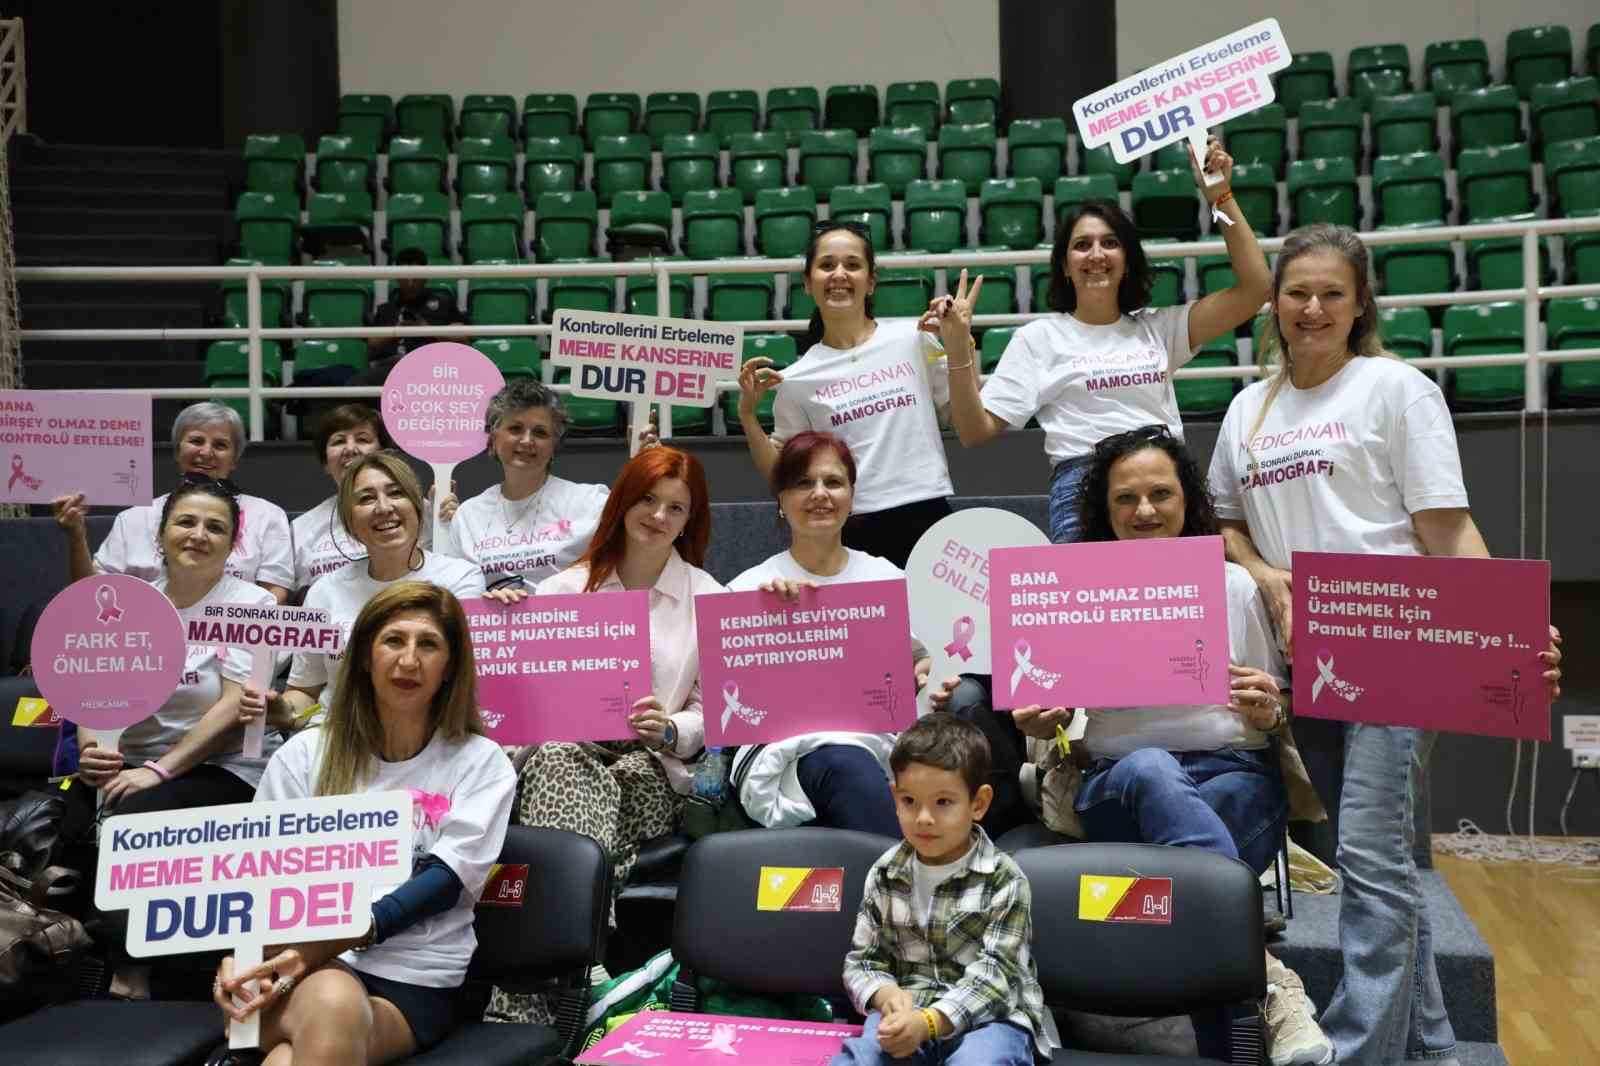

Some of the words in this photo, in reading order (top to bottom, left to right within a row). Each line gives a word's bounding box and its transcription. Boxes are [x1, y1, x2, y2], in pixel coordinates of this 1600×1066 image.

[1081, 63, 1186, 118] Kontrollerini
[1189, 29, 1271, 71] Erteleme
[1087, 99, 1152, 137] MEME
[1120, 104, 1195, 153] DUR
[1200, 77, 1262, 119] DE!
[559, 317, 657, 339] Kontrollerini
[661, 326, 735, 346] Erteleme
[559, 339, 616, 359] MEME
[432, 363, 458, 379] BİR
[581, 364, 646, 394] DUR
[655, 370, 706, 399] DE!
[47, 418, 97, 430] OLMAZ
[100, 420, 141, 431] DEME!
[73, 435, 145, 447] ERTELEME!
[1010, 571, 1059, 586] BANA
[1307, 575, 1410, 598] ÜzülMEMEk
[1416, 587, 1438, 599] ve
[1010, 588, 1070, 608] BİRŞEY
[1076, 588, 1139, 603] OLMAZ
[1144, 584, 1199, 600] DEME!
[282, 610, 327, 623] DURAK:
[511, 608, 579, 626] KENDİNE
[720, 610, 788, 630] KENDİMİ
[791, 604, 886, 625] SEVİYORUM
[1011, 605, 1105, 627] KONTROLÜ
[1110, 605, 1205, 622] ERTELEME!
[1307, 596, 1393, 619] ÜzMEMEk
[1399, 604, 1431, 624] için
[64, 632, 119, 649] FARK
[124, 631, 152, 650] ET,
[511, 622, 599, 641] MUAYENESİ
[604, 621, 635, 641] İÇİN
[721, 624, 849, 649] KONTROLLERİMİ
[1308, 620, 1367, 638] Pamuk
[1372, 624, 1412, 641] Eller
[1417, 627, 1501, 649] MEME'ye
[496, 645, 517, 659] AY
[723, 646, 844, 669] YAPTIRIYORUM
[53, 653, 125, 675] ÖNLEM
[130, 655, 163, 672] AL!
[522, 660, 567, 675] ELLER
[571, 657, 640, 673] MEME'ye
[112, 815, 271, 852] Kontrollerini
[279, 808, 399, 836] Erteleme
[110, 856, 203, 891] MEME
[498, 880, 523, 898] A-3
[811, 884, 840, 904] A-2
[145, 891, 254, 943] DUR
[268, 882, 354, 931] DE!
